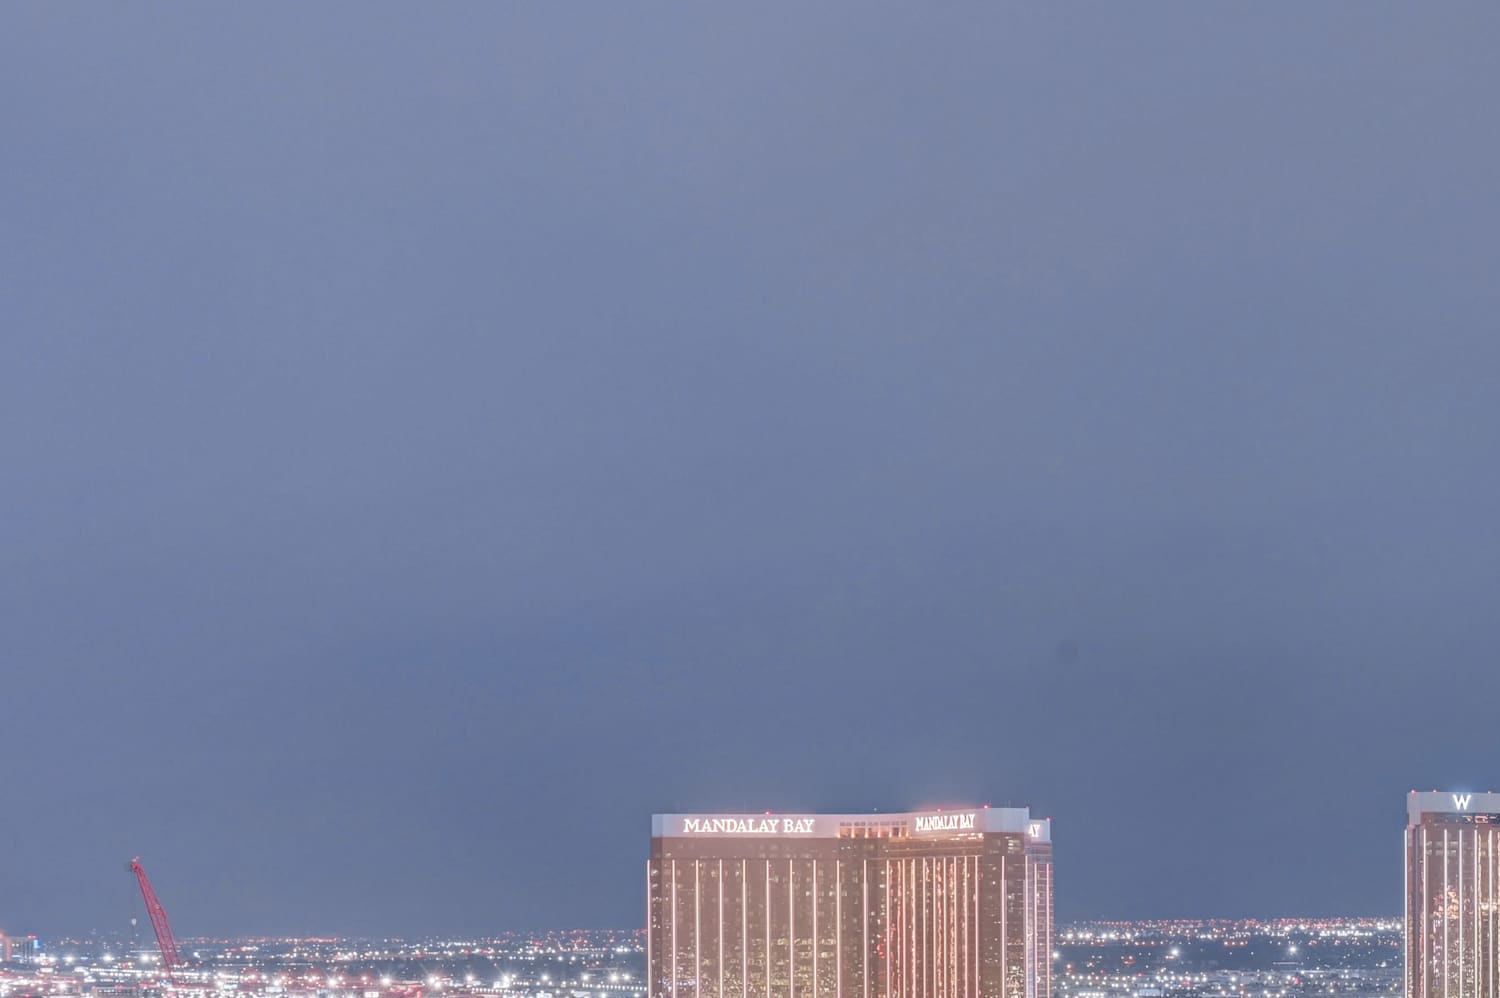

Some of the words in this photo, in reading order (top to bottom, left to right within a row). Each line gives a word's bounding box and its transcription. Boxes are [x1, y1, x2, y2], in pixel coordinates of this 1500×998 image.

[1452, 794, 1472, 810] W
[683, 818, 780, 833] MANDALAY
[783, 818, 815, 833] BAY
[915, 815, 960, 832] MANDALAY
[960, 814, 976, 829] BAY
[1028, 823, 1041, 838] AY
